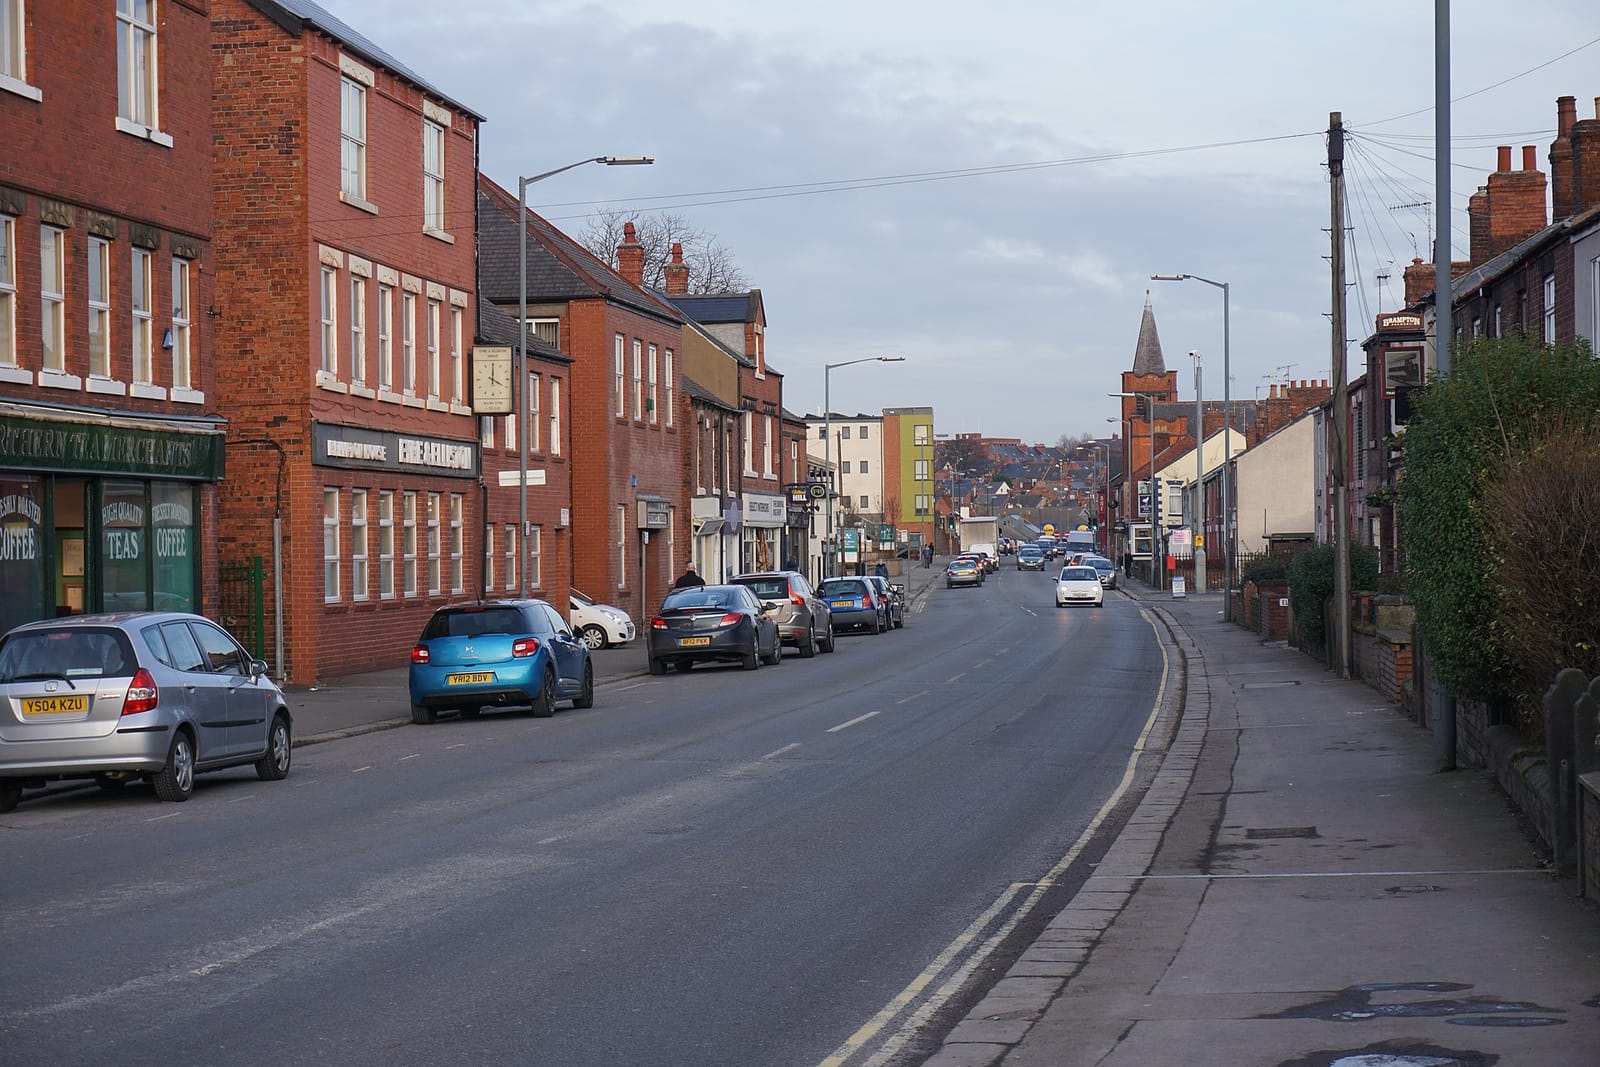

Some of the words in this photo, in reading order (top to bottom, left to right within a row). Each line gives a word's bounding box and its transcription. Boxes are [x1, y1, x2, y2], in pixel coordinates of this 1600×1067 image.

[1382, 316, 1421, 327] BRAMPTON
[70, 431, 101, 461] TEA
[103, 434, 192, 469] MERCHANTS
[102, 503, 118, 526] HIGH
[118, 502, 143, 526] QUALITY
[107, 532, 139, 559] TEAS
[156, 528, 187, 557] COFFEE
[453, 674, 471, 684] YR12
[472, 673, 488, 682] BDV
[26, 699, 57, 712] YS04
[59, 698, 82, 711] KZU
